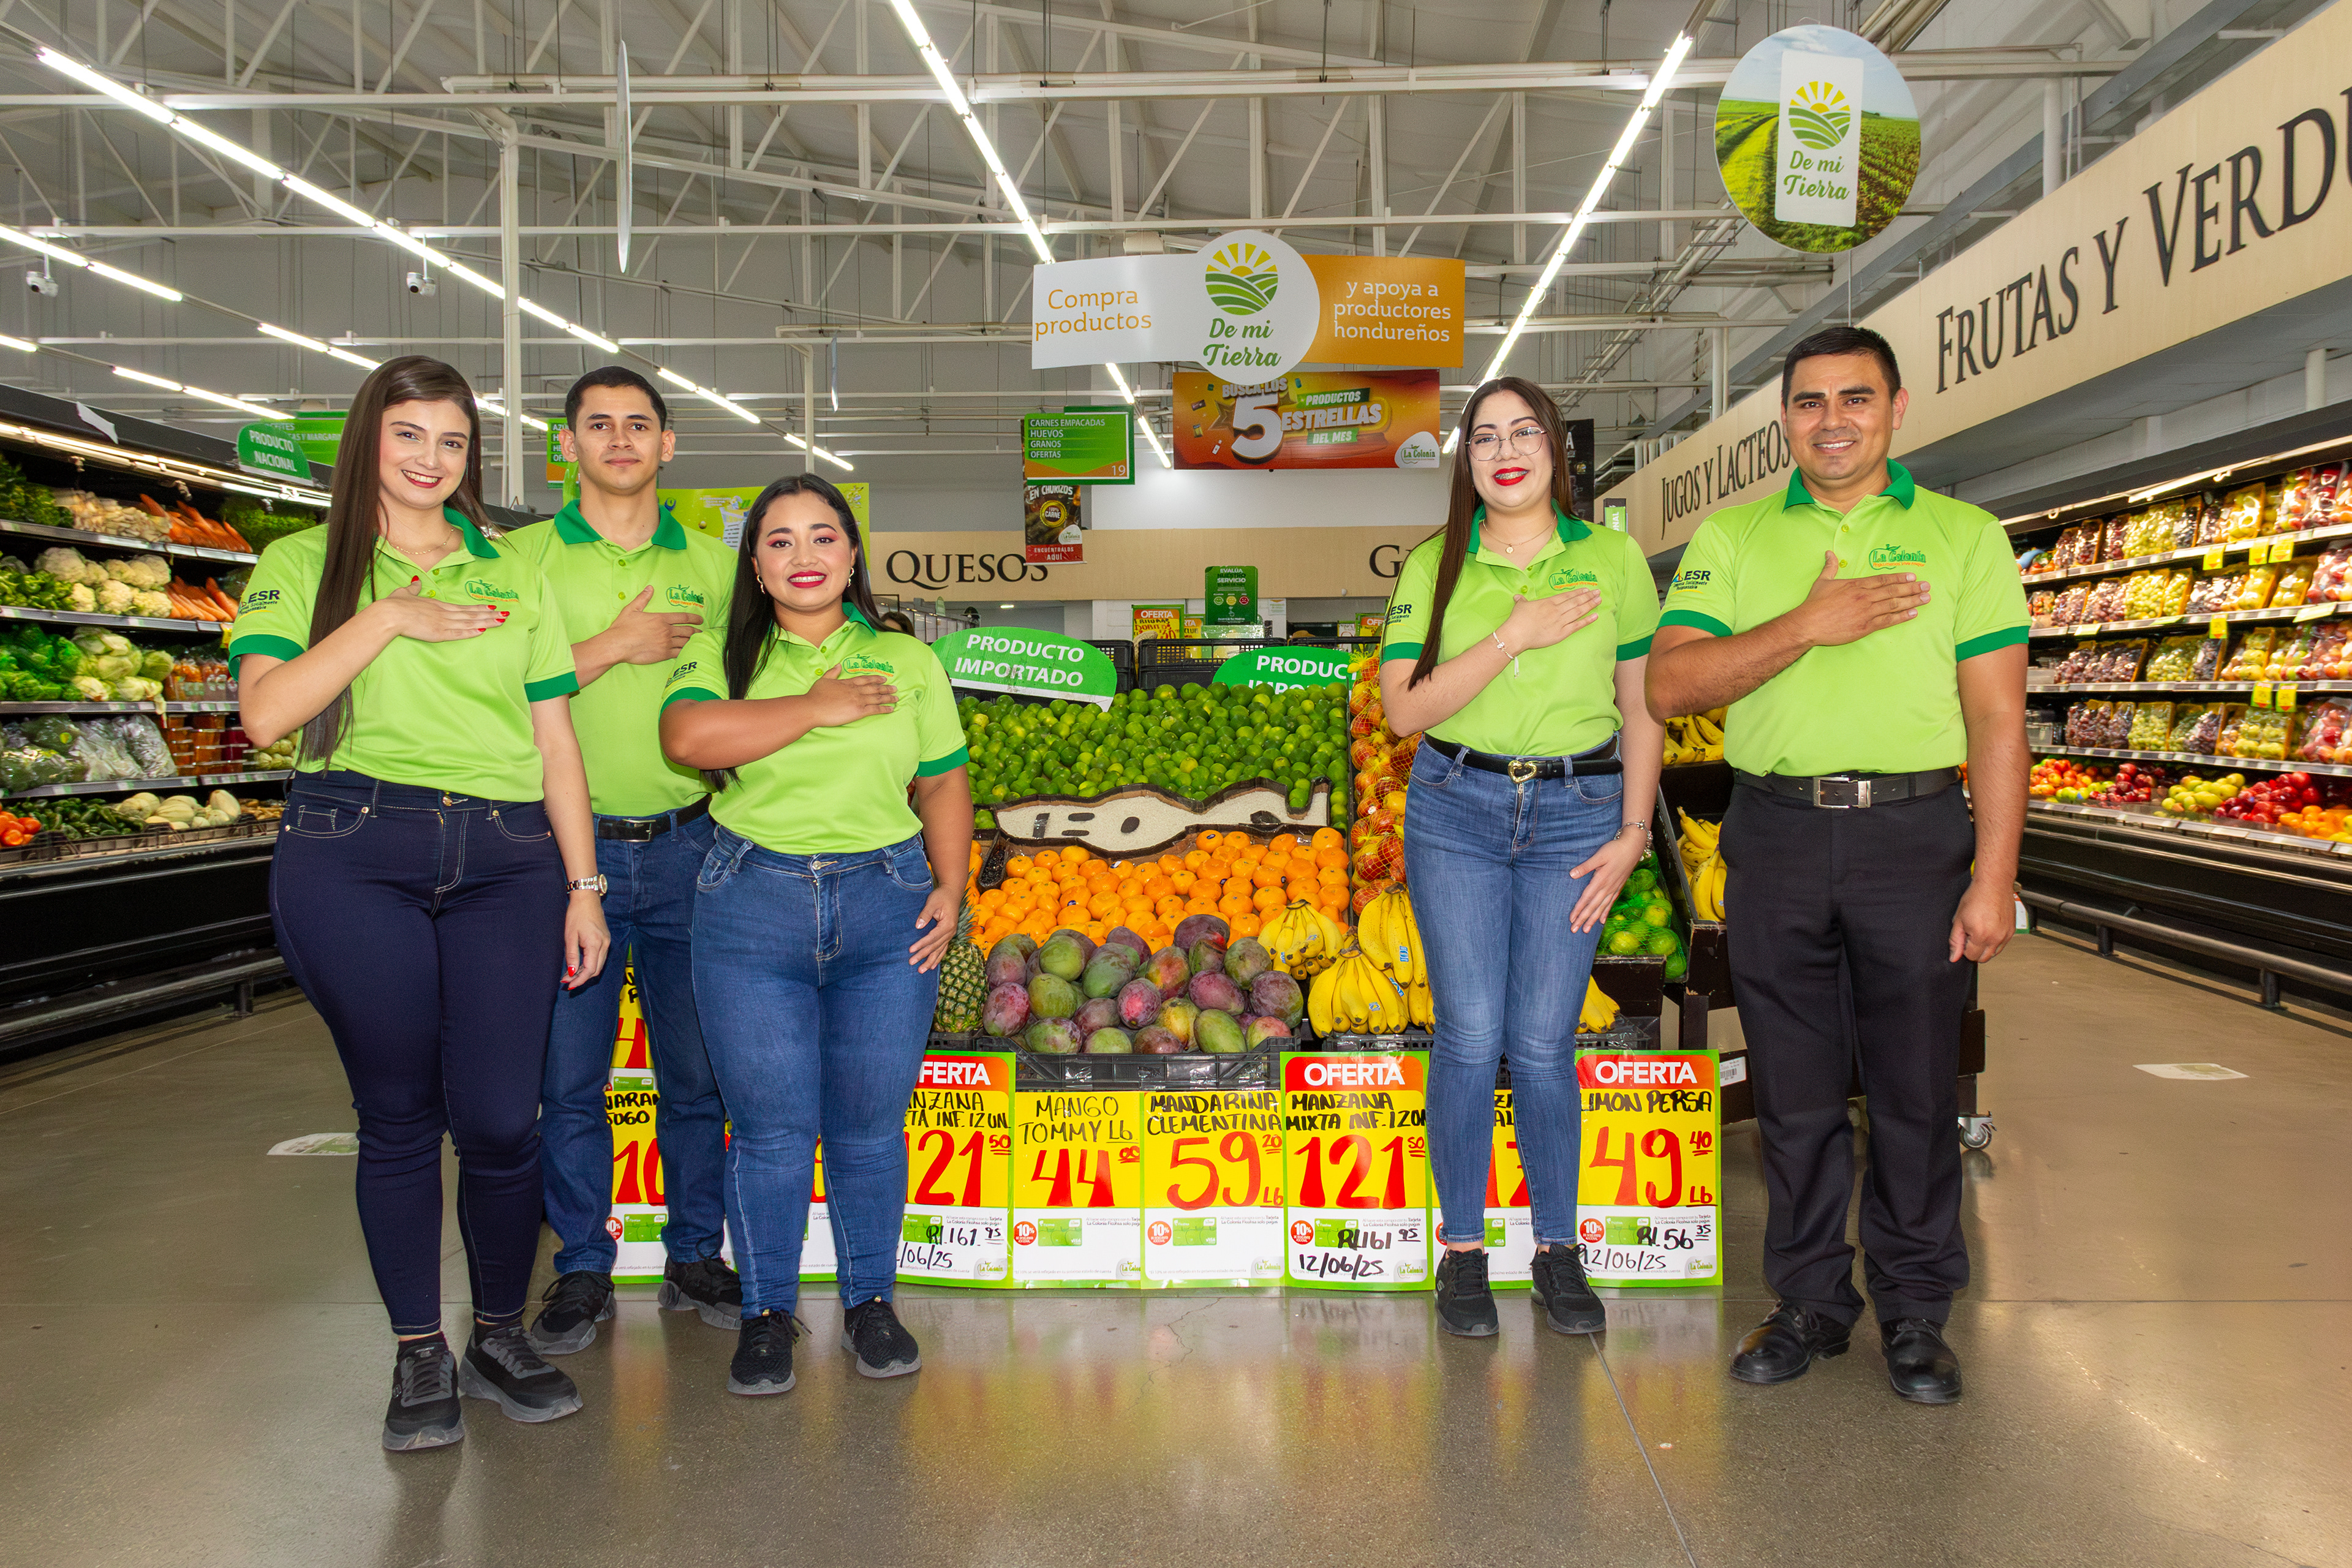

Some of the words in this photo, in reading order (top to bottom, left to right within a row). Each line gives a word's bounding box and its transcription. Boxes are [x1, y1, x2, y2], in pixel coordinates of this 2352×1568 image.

[1790, 150, 1814, 170] De
[1817, 156, 1844, 173] mi
[1784, 175, 1850, 200] Tierra
[1048, 288, 1139, 311] Compra
[1346, 281, 1358, 298] y
[1363, 281, 1422, 300] apoya
[1428, 284, 1439, 297] a
[1333, 300, 1452, 319] productores
[1936, 246, 2079, 394] FRUTAS
[2092, 216, 2129, 314] Y
[1035, 312, 1152, 341] productos
[1209, 318, 1237, 338] De
[1242, 320, 1274, 339] mi
[1334, 320, 1450, 342] hondureños
[1203, 344, 1282, 367] Tierra
[1222, 383, 1262, 398] BUSCA
[1264, 377, 1288, 393] LOS
[1305, 390, 1362, 405] PRODUCTOS
[1060, 418, 1106, 427] EMPACADAS
[1231, 391, 1284, 462] 5
[1281, 404, 1382, 431] ESTRELLAS
[249, 429, 295, 453] PRODUCTO
[1313, 432, 1329, 444] DEL
[1332, 431, 1352, 443] MES
[254, 450, 298, 472] NACIONAL
[1404, 449, 1412, 458] La
[1111, 465, 1126, 476] 19
[1662, 466, 1700, 540] JUGOS
[1703, 458, 1714, 505] Y
[1873, 551, 1887, 562] La
[886, 550, 1048, 590] QUESOS
[1553, 575, 1565, 586] La
[1684, 570, 1711, 581] ESR
[248, 590, 280, 603] ESR
[469, 582, 483, 595] La
[670, 589, 680, 599] La
[1390, 604, 1412, 616] ESR
[967, 634, 1084, 662] PRODUCTO
[673, 662, 697, 678] ESR
[847, 659, 860, 669] La
[954, 657, 1083, 686] IMPORTADO
[918, 1061, 991, 1085] FERTA
[1304, 1063, 1406, 1087] OFERTA
[1595, 1060, 1698, 1084] OFERTA
[909, 1091, 984, 1112] NZANA
[1036, 1095, 1119, 1121] MANGO
[1150, 1092, 1278, 1114] MANDARINA
[1291, 1092, 1394, 1111] MANZANA
[1581, 1092, 1643, 1112] LIMON
[1646, 1089, 1712, 1114] PERSA
[1018, 1119, 1102, 1145] TOMMY
[1147, 1113, 1283, 1136] CLEMENTINA
[1286, 1113, 1341, 1131] MIXTA
[989, 1134, 1011, 1150] 50
[1166, 1131, 1261, 1212] 59
[1262, 1134, 1283, 1148] 20
[1293, 1134, 1407, 1210] 121
[1407, 1136, 1425, 1150] 50
[1588, 1126, 1683, 1208] 49
[1689, 1130, 1713, 1150] 40
[1030, 1148, 1115, 1208] 44
[1263, 1186, 1284, 1207] Lb
[1689, 1185, 1713, 1204] Lb
[984, 1227, 1002, 1239] 95
[1017, 1224, 1035, 1237] 10%
[1151, 1223, 1170, 1237] 10%
[1294, 1223, 1312, 1236] 10%
[1398, 1228, 1419, 1241] 95
[1584, 1221, 1602, 1234] 10%
[1664, 1228, 1694, 1250] 56
[1696, 1224, 1711, 1235] 35
[896, 1242, 953, 1270] /06/25
[1299, 1252, 1384, 1281] 12/06/25
